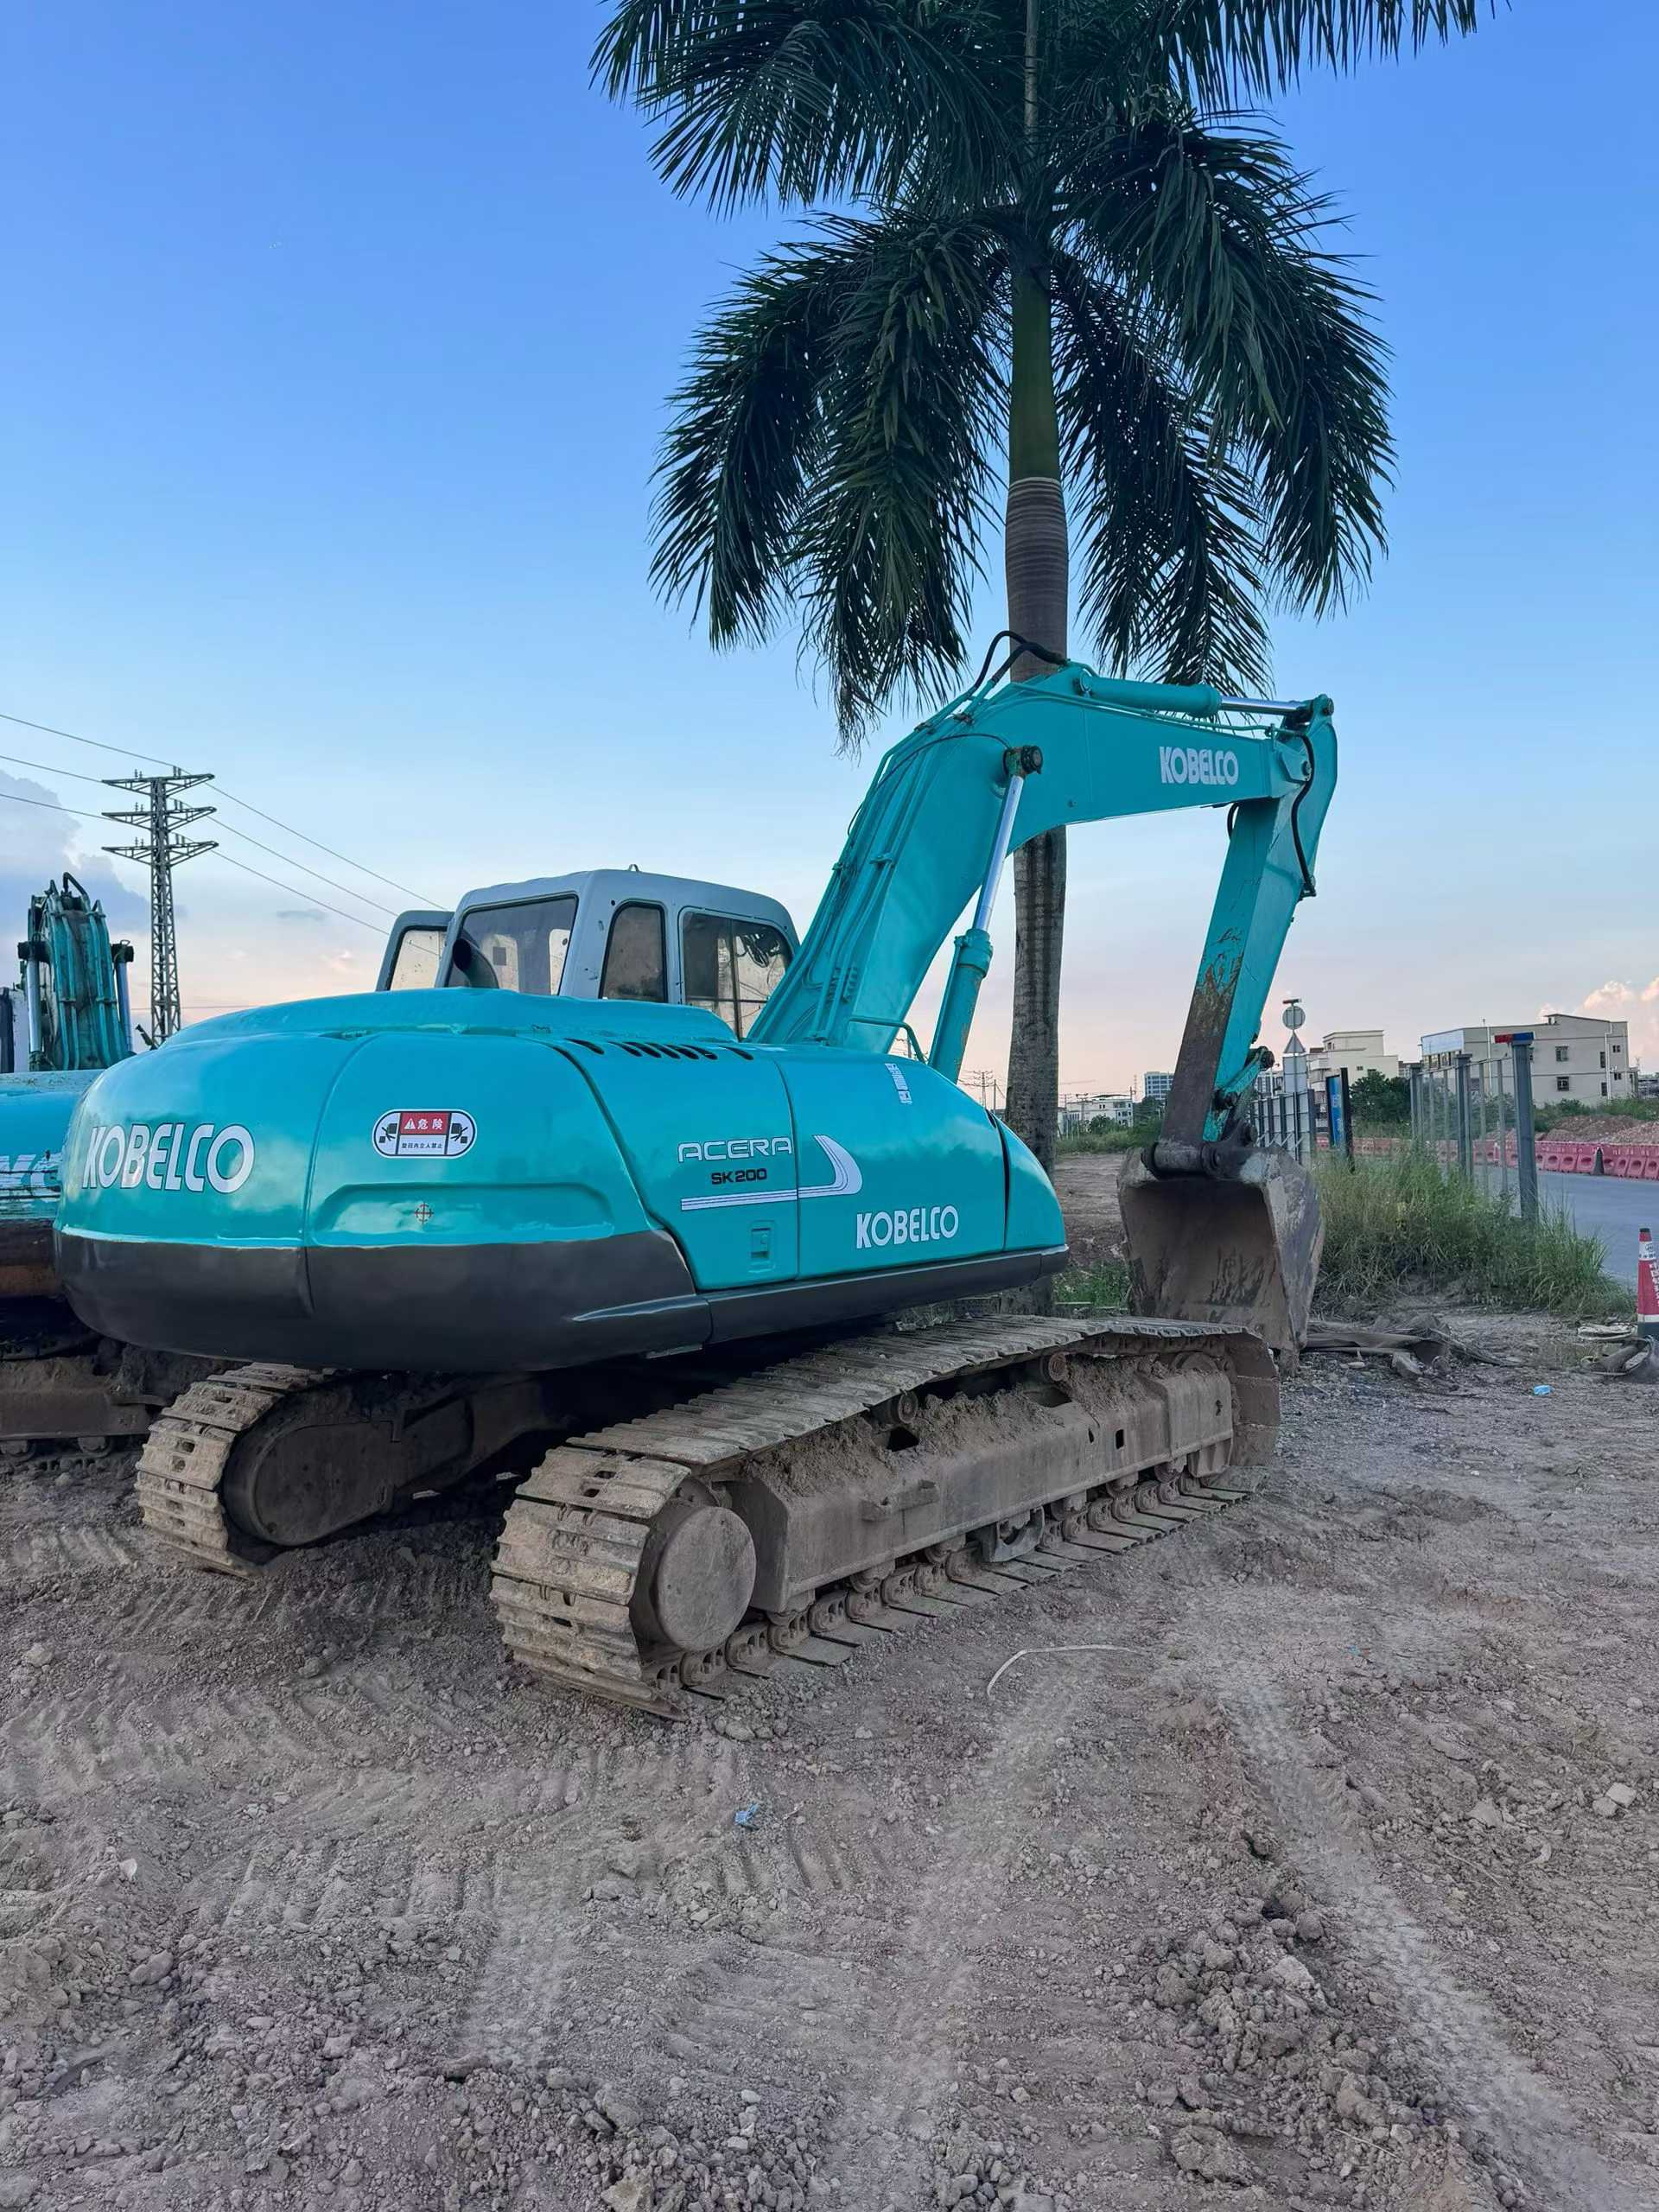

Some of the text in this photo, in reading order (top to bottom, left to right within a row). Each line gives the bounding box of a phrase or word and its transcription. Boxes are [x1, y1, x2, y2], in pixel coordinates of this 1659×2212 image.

[1159, 746, 1239, 785] KOBELCO
[81, 1122, 256, 1194] KOBELCO
[677, 1136, 793, 1163] ACERA
[711, 1168, 767, 1185] SK200
[856, 1205, 959, 1249] KOBELCO
